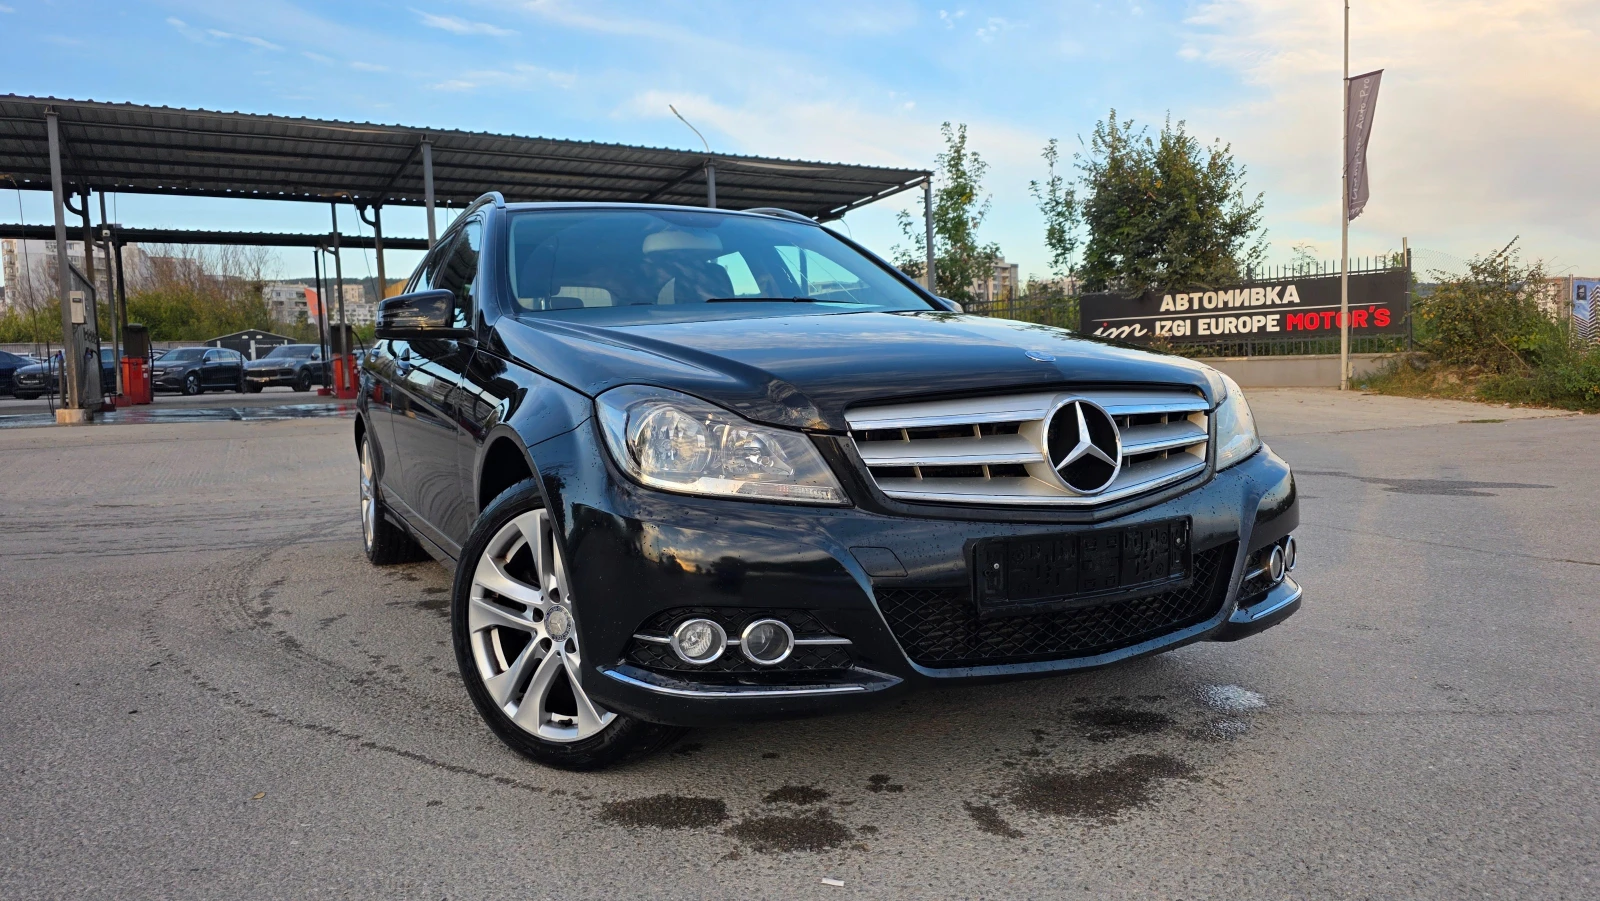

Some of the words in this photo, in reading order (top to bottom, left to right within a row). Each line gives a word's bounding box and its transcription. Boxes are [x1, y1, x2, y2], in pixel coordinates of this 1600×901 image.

[1360, 78, 1370, 98] Pro
[1160, 285, 1300, 312] АВТОМИВКА
[1155, 320, 1191, 336] IZGI
[1198, 314, 1280, 335] EUROPE
[1286, 305, 1391, 331] MOTOR'S
